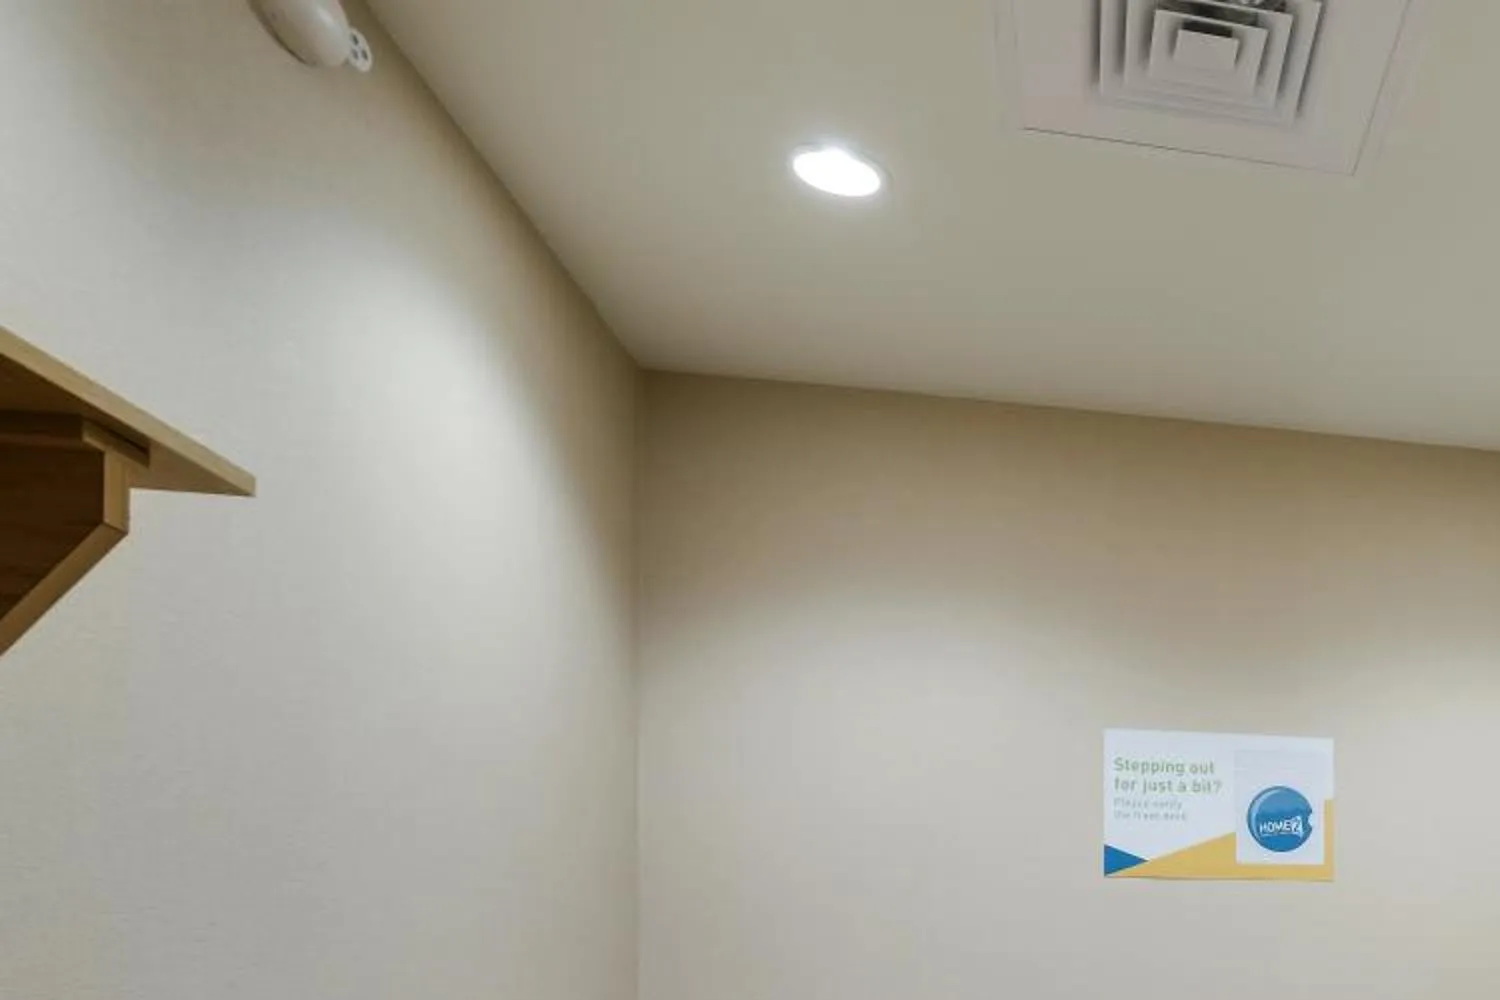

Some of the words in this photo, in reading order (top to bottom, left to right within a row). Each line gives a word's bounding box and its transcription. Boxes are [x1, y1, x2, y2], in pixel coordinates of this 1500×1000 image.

[1113, 757, 1185, 777] Stepping
[1189, 761, 1215, 775] out
[1114, 776, 1136, 791] for
[1142, 778, 1174, 795] just
[1177, 780, 1187, 793] a
[1191, 780, 1223, 793] bit?
